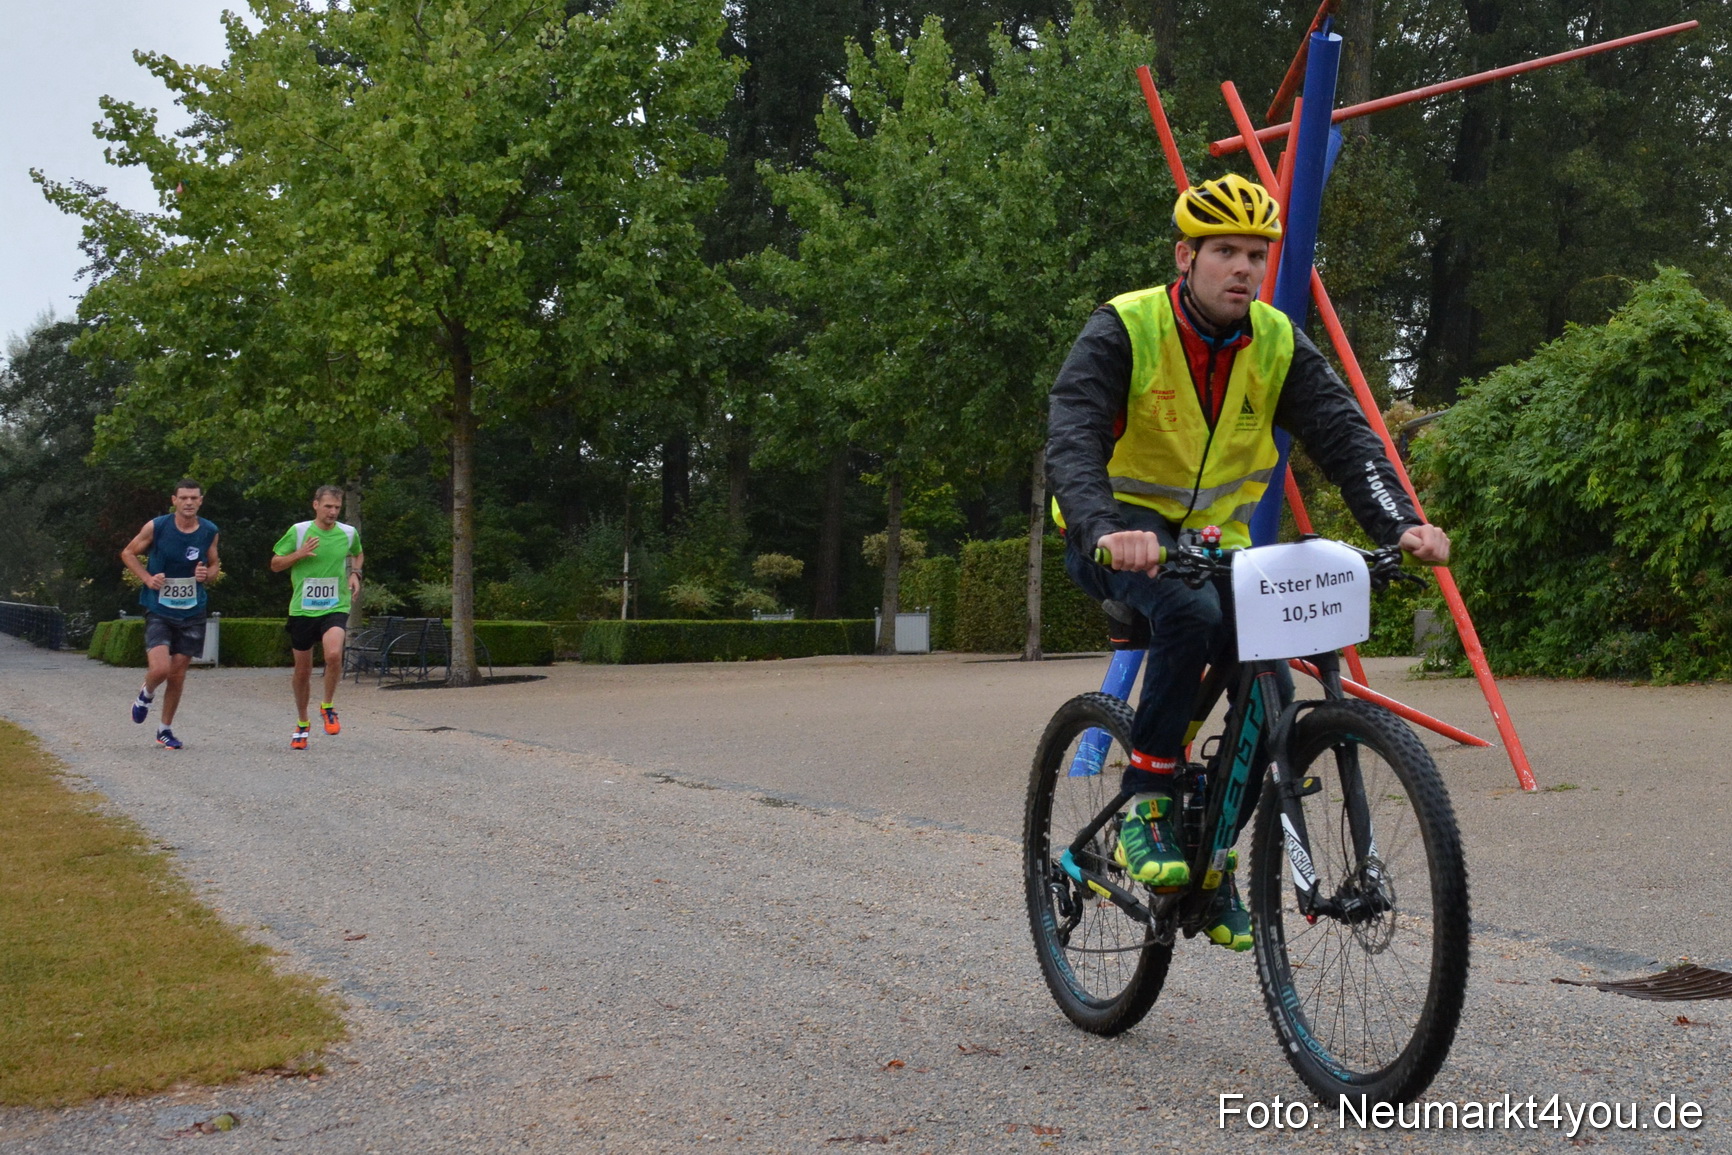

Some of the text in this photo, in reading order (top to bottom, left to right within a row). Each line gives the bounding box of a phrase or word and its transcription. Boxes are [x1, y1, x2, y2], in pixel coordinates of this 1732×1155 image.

[163, 584, 194, 598] 2833
[306, 584, 335, 598] 2001
[1259, 570, 1354, 596] Erster Mann
[1282, 601, 1342, 623] 10,5 km
